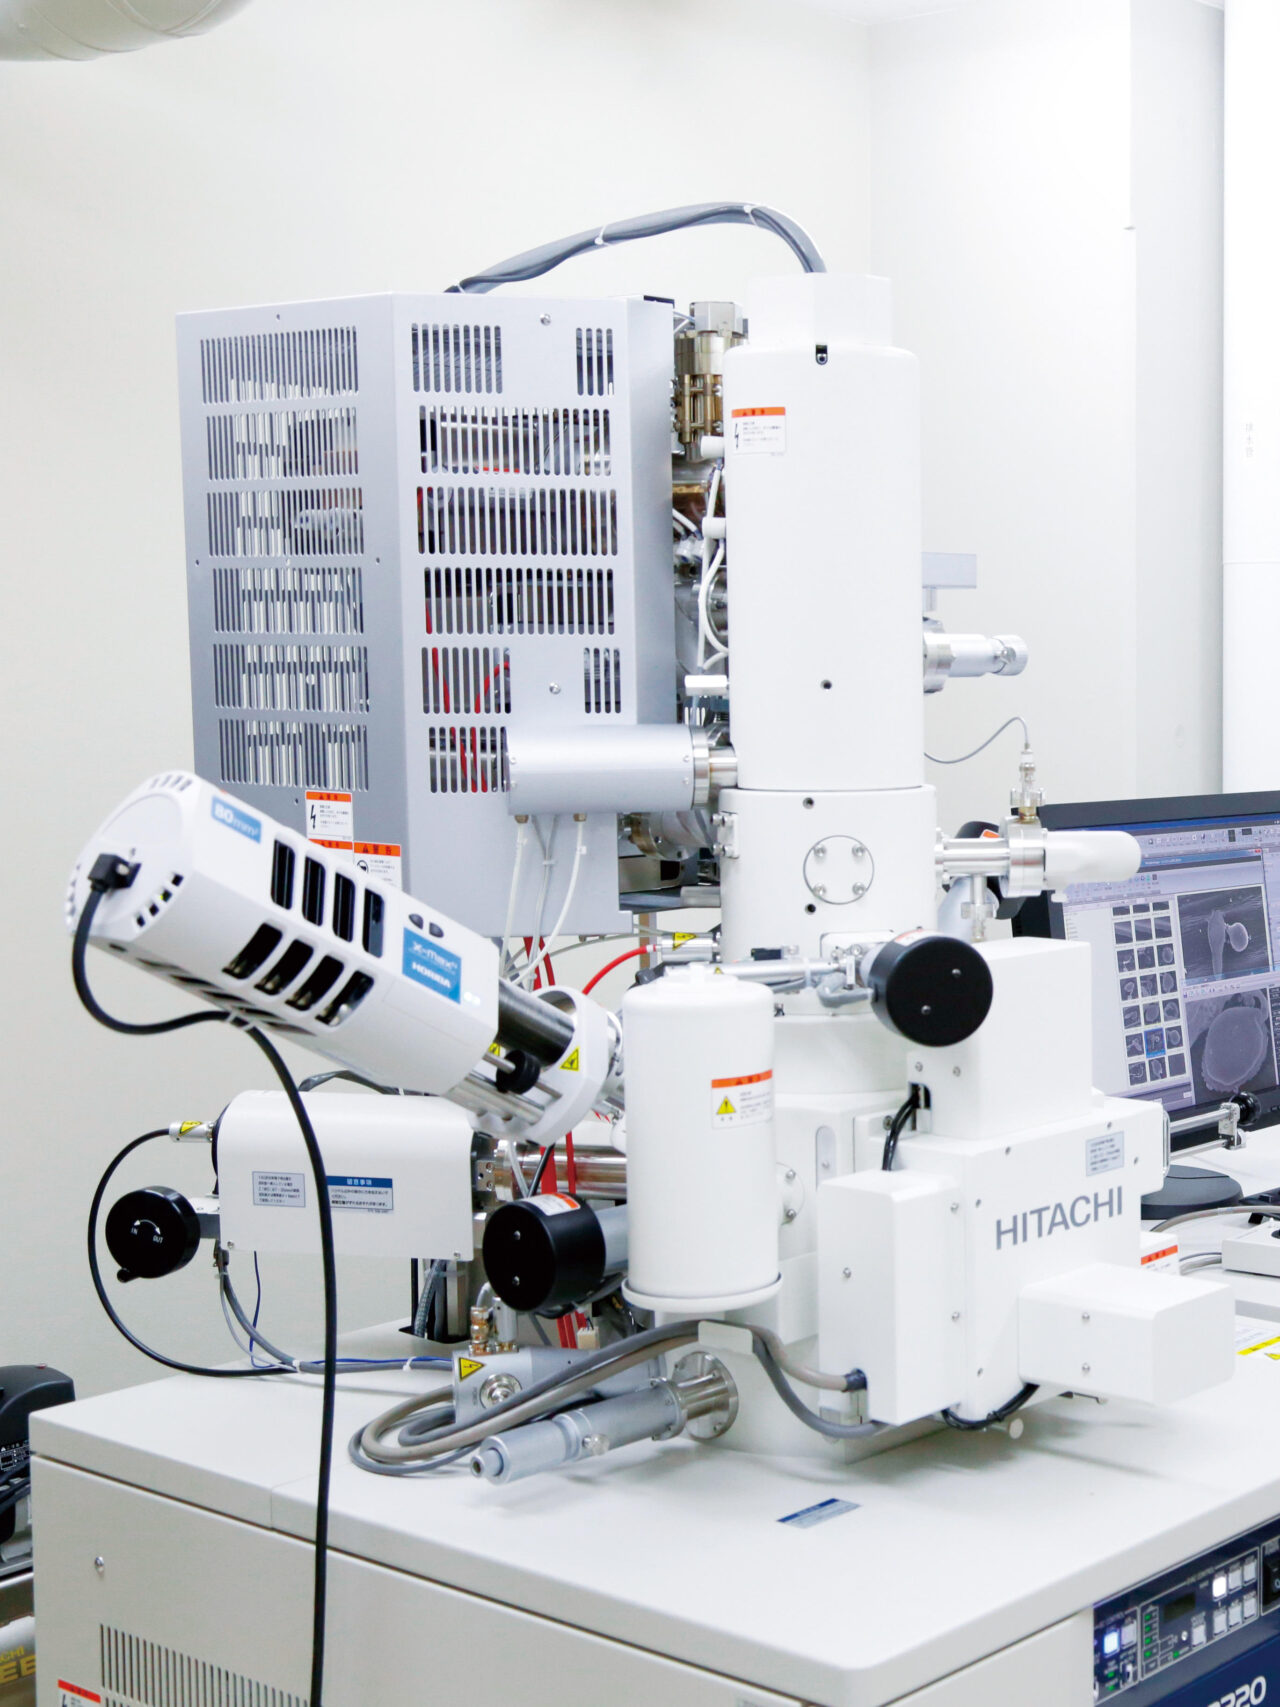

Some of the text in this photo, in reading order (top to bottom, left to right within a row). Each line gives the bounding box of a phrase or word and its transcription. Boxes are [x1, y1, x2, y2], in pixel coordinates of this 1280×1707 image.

[996, 1185, 1123, 1250] HITACHI
[130, 1227, 139, 1236] IN
[152, 1234, 164, 1244] OUT
